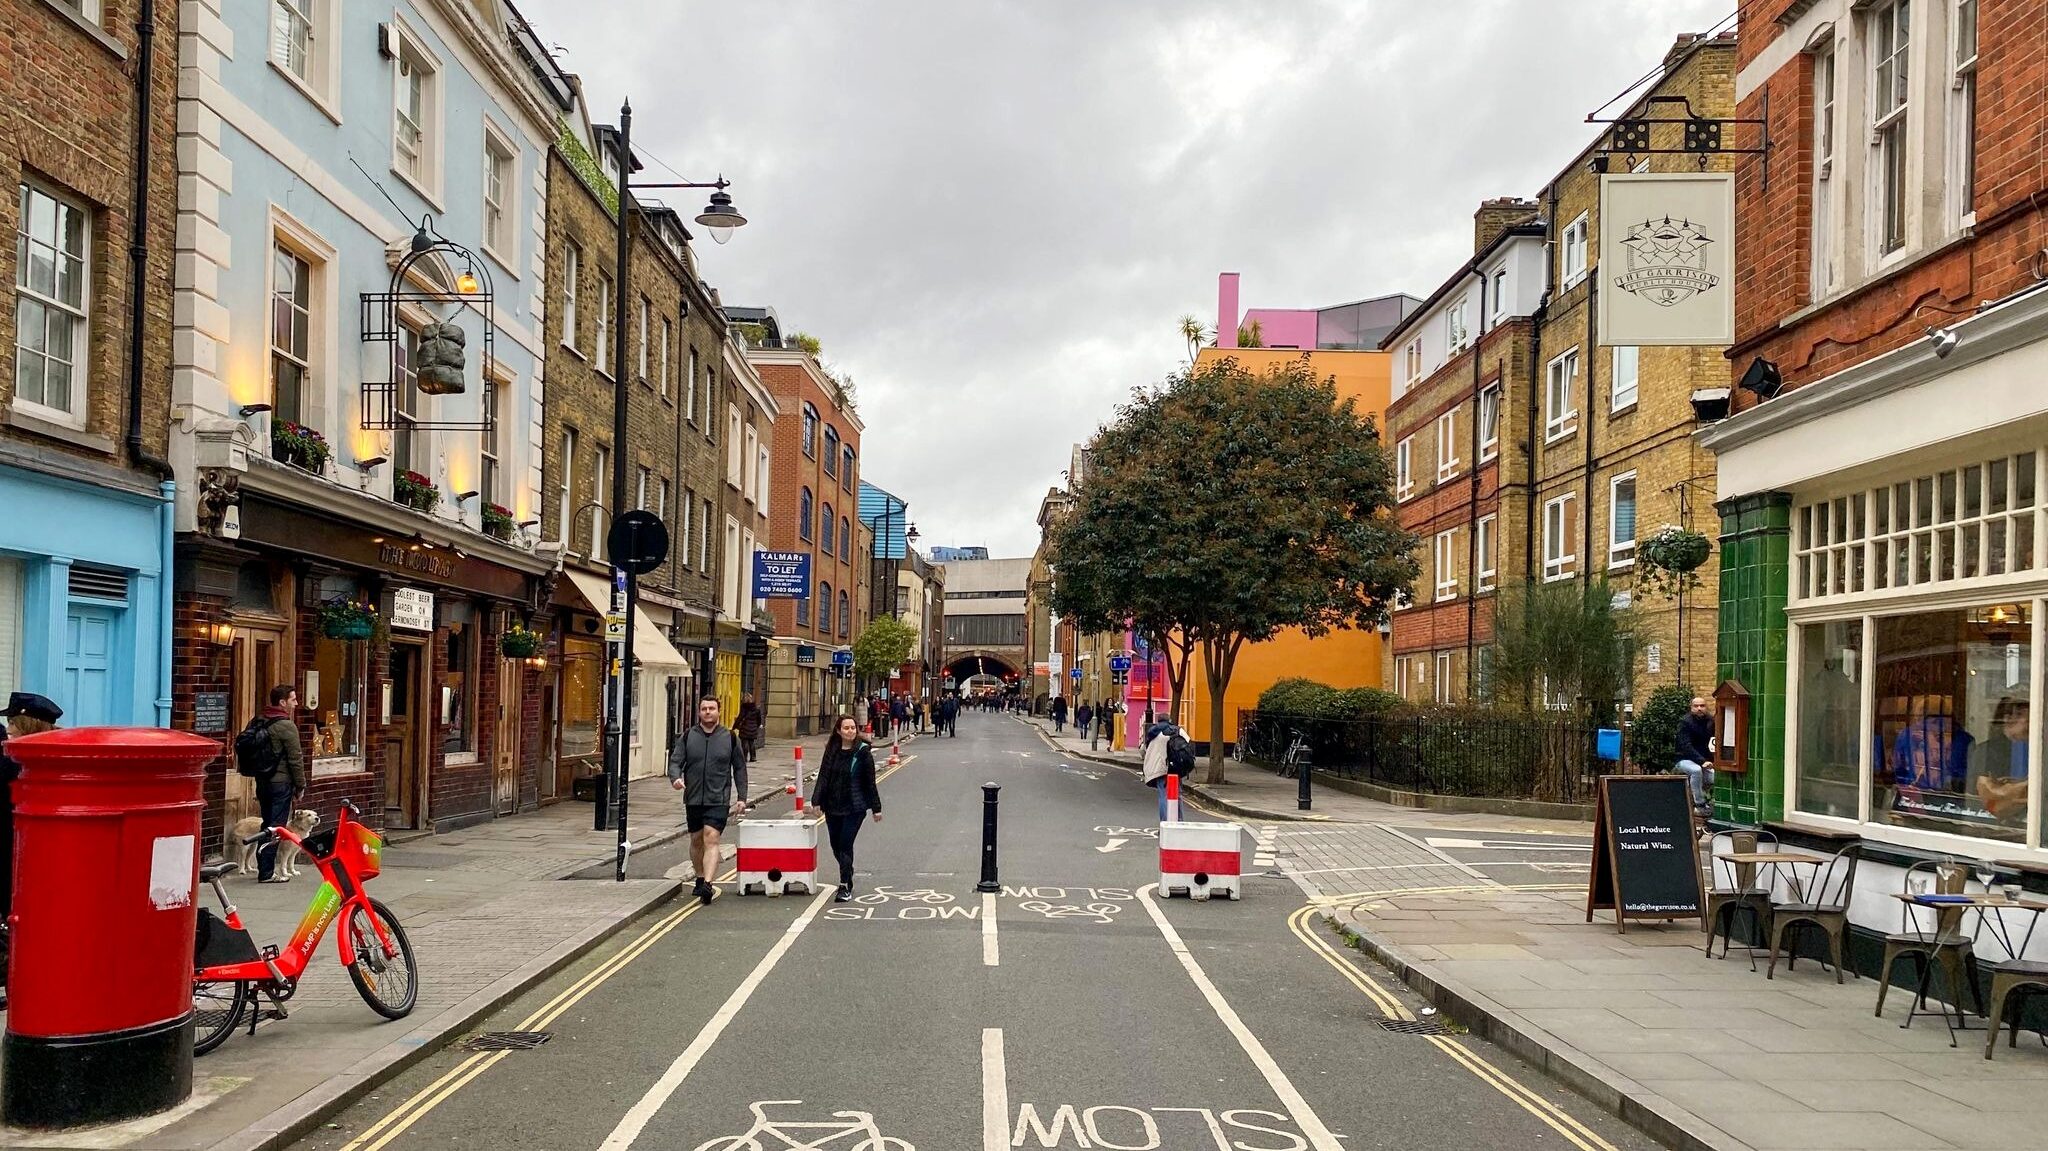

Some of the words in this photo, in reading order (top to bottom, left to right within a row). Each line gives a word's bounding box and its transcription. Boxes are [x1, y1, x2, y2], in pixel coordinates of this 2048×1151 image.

[1618, 272, 1640, 283] THE
[1647, 269, 1716, 284] GARRISON
[1629, 279, 1666, 290] PUBLIC
[1671, 279, 1705, 289] HOUSE
[382, 543, 405, 565] THE
[781, 566, 797, 574] LET
[418, 593, 430, 603] BEER
[395, 602, 413, 613] GARDEN
[418, 606, 425, 615] ON
[1618, 825, 1640, 834] Local
[1640, 825, 1671, 834] Produce
[1620, 842, 1649, 850] Natural
[1650, 841, 1675, 850] Wine.
[1000, 885, 1134, 900] SLOW
[823, 906, 981, 921] SLOW
[1625, 903, 1697, 912] hello@thegarrison.co.uk
[300, 932, 316, 955] JUMP
[312, 927, 320, 936] is
[316, 911, 329, 929] now
[324, 893, 339, 913] Lime
[1010, 1103, 1308, 1151] SLOW
